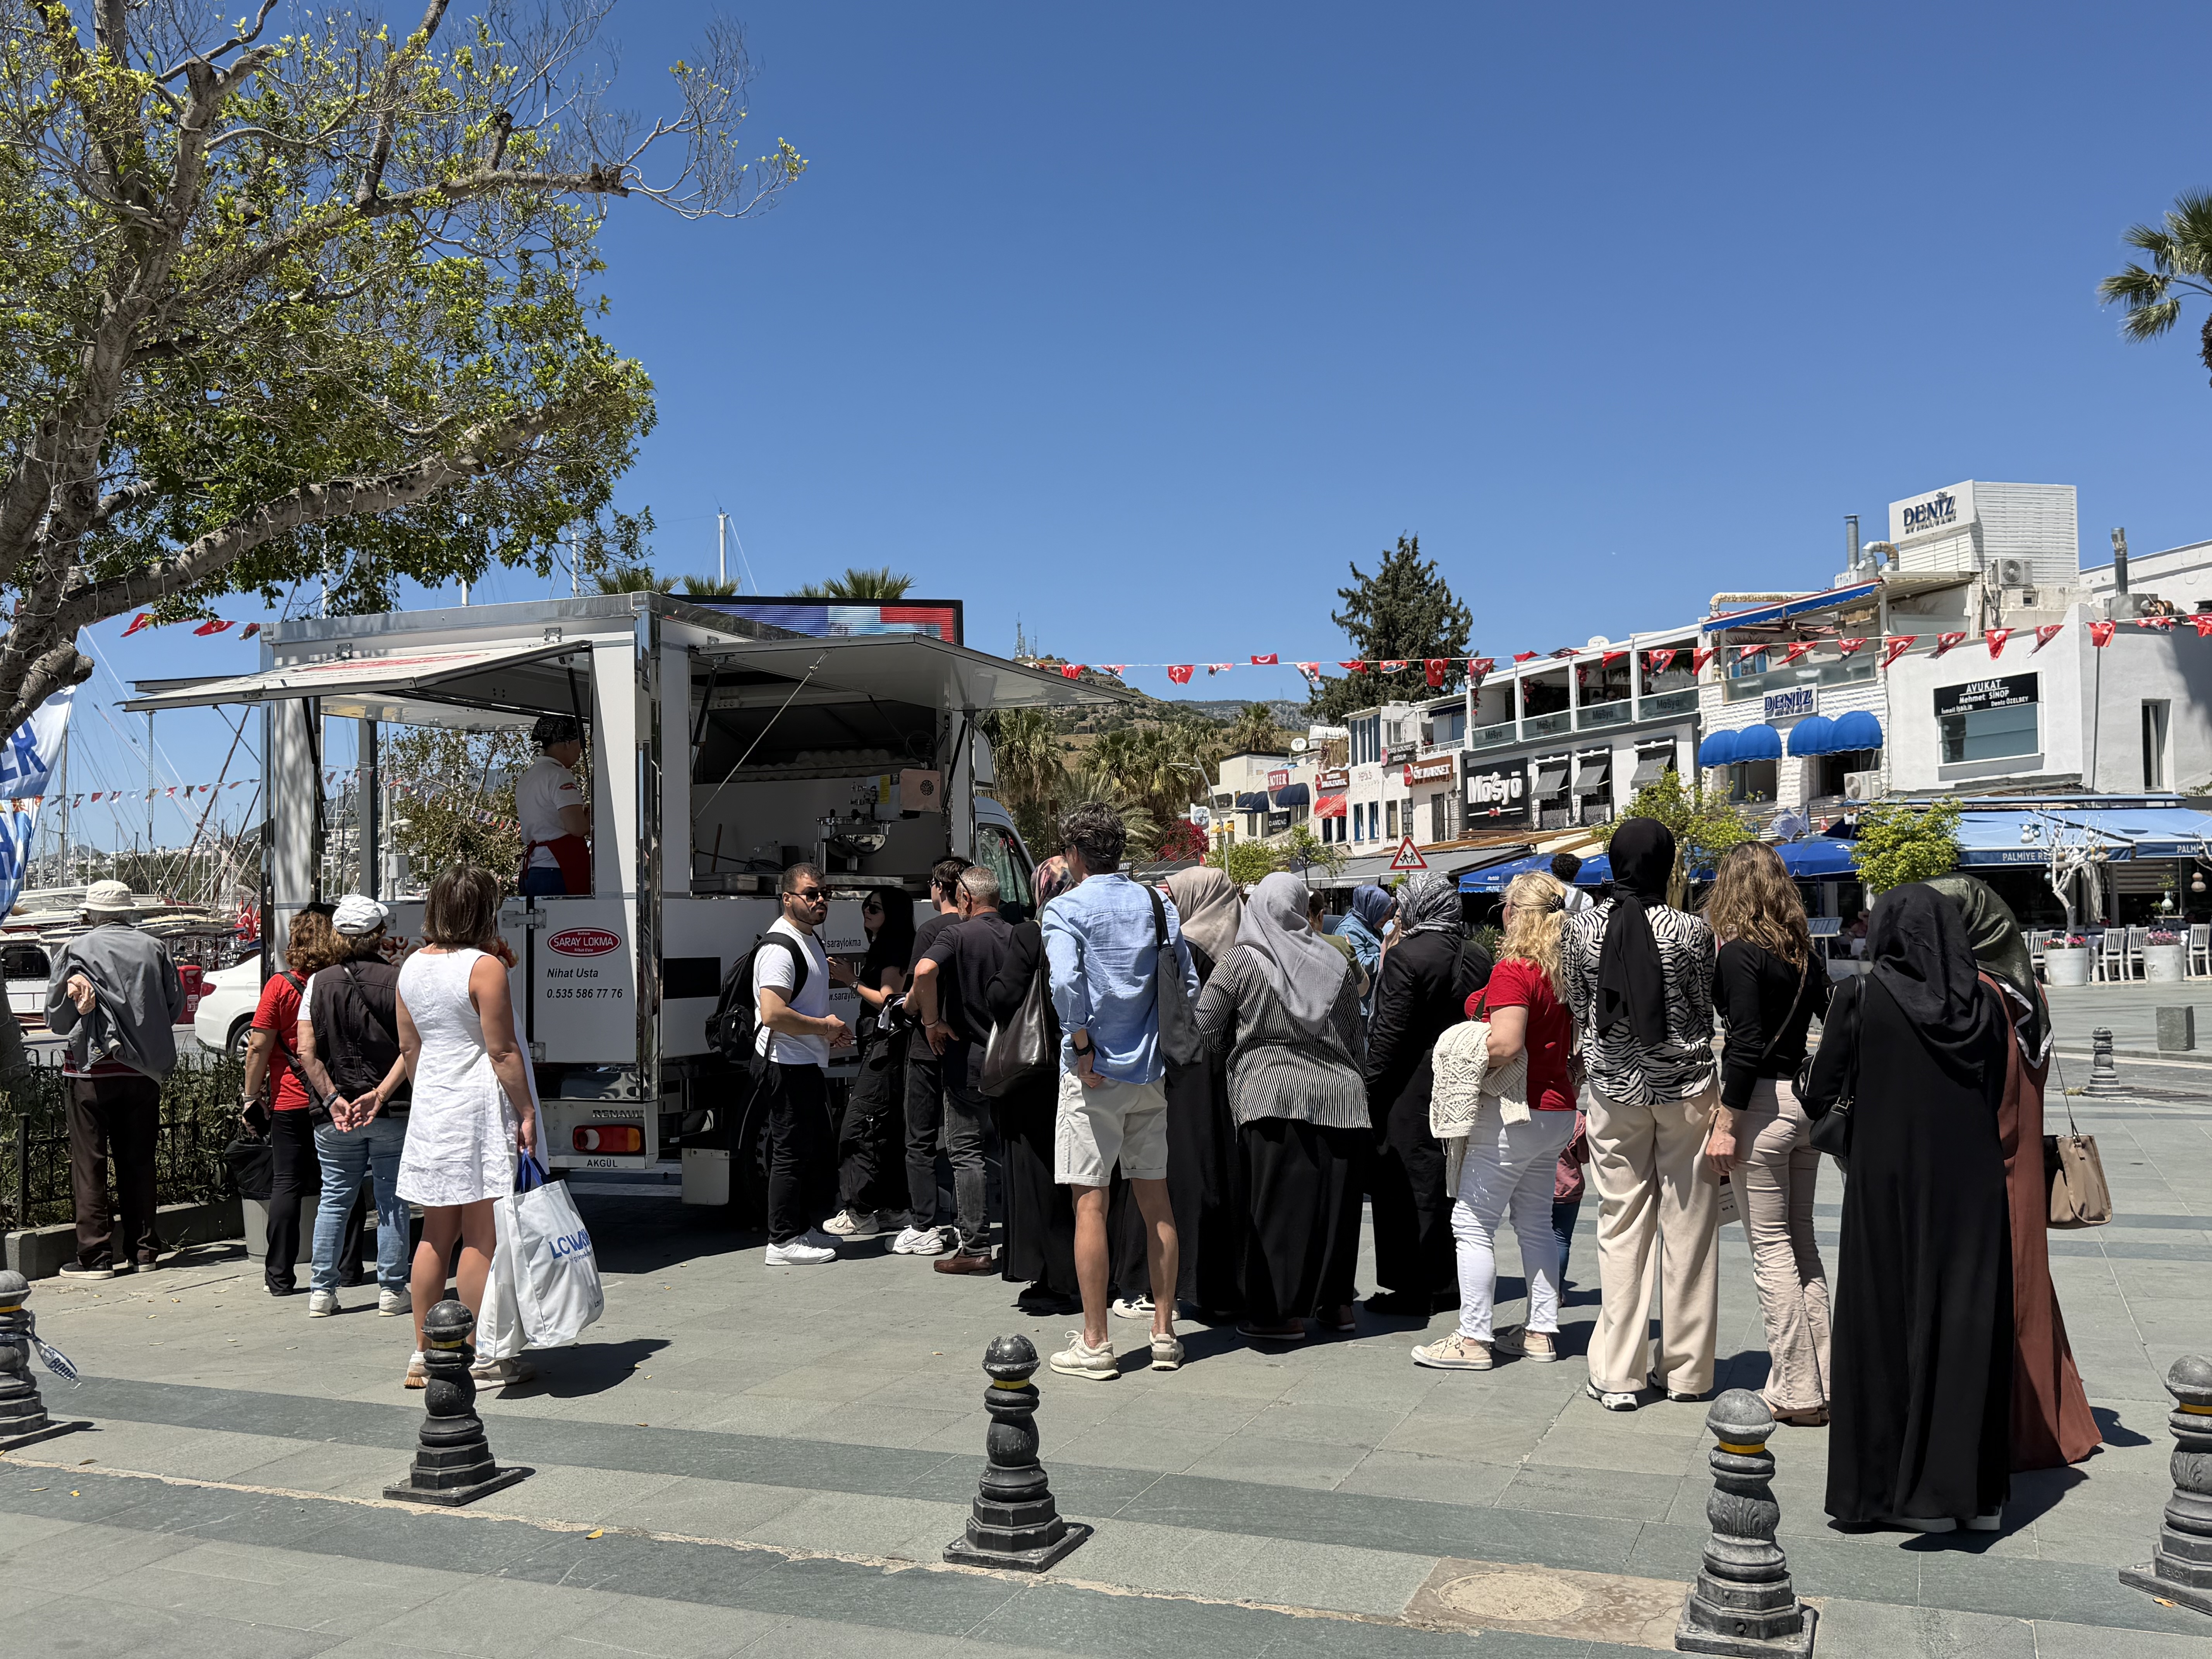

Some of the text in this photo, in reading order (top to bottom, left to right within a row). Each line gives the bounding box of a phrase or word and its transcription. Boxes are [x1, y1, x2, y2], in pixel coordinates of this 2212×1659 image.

[1966, 679, 2002, 694] AVUKAT
[1959, 689, 2010, 704] Mehmet SİNOP
[2002, 851, 2036, 862] PALMİYE
[554, 937, 613, 946] SARAY LOKMA
[547, 968, 599, 978] Nihat Usta
[547, 988, 623, 998] 0.535 586 77 76
[587, 1158, 618, 1168] AKGÜL
